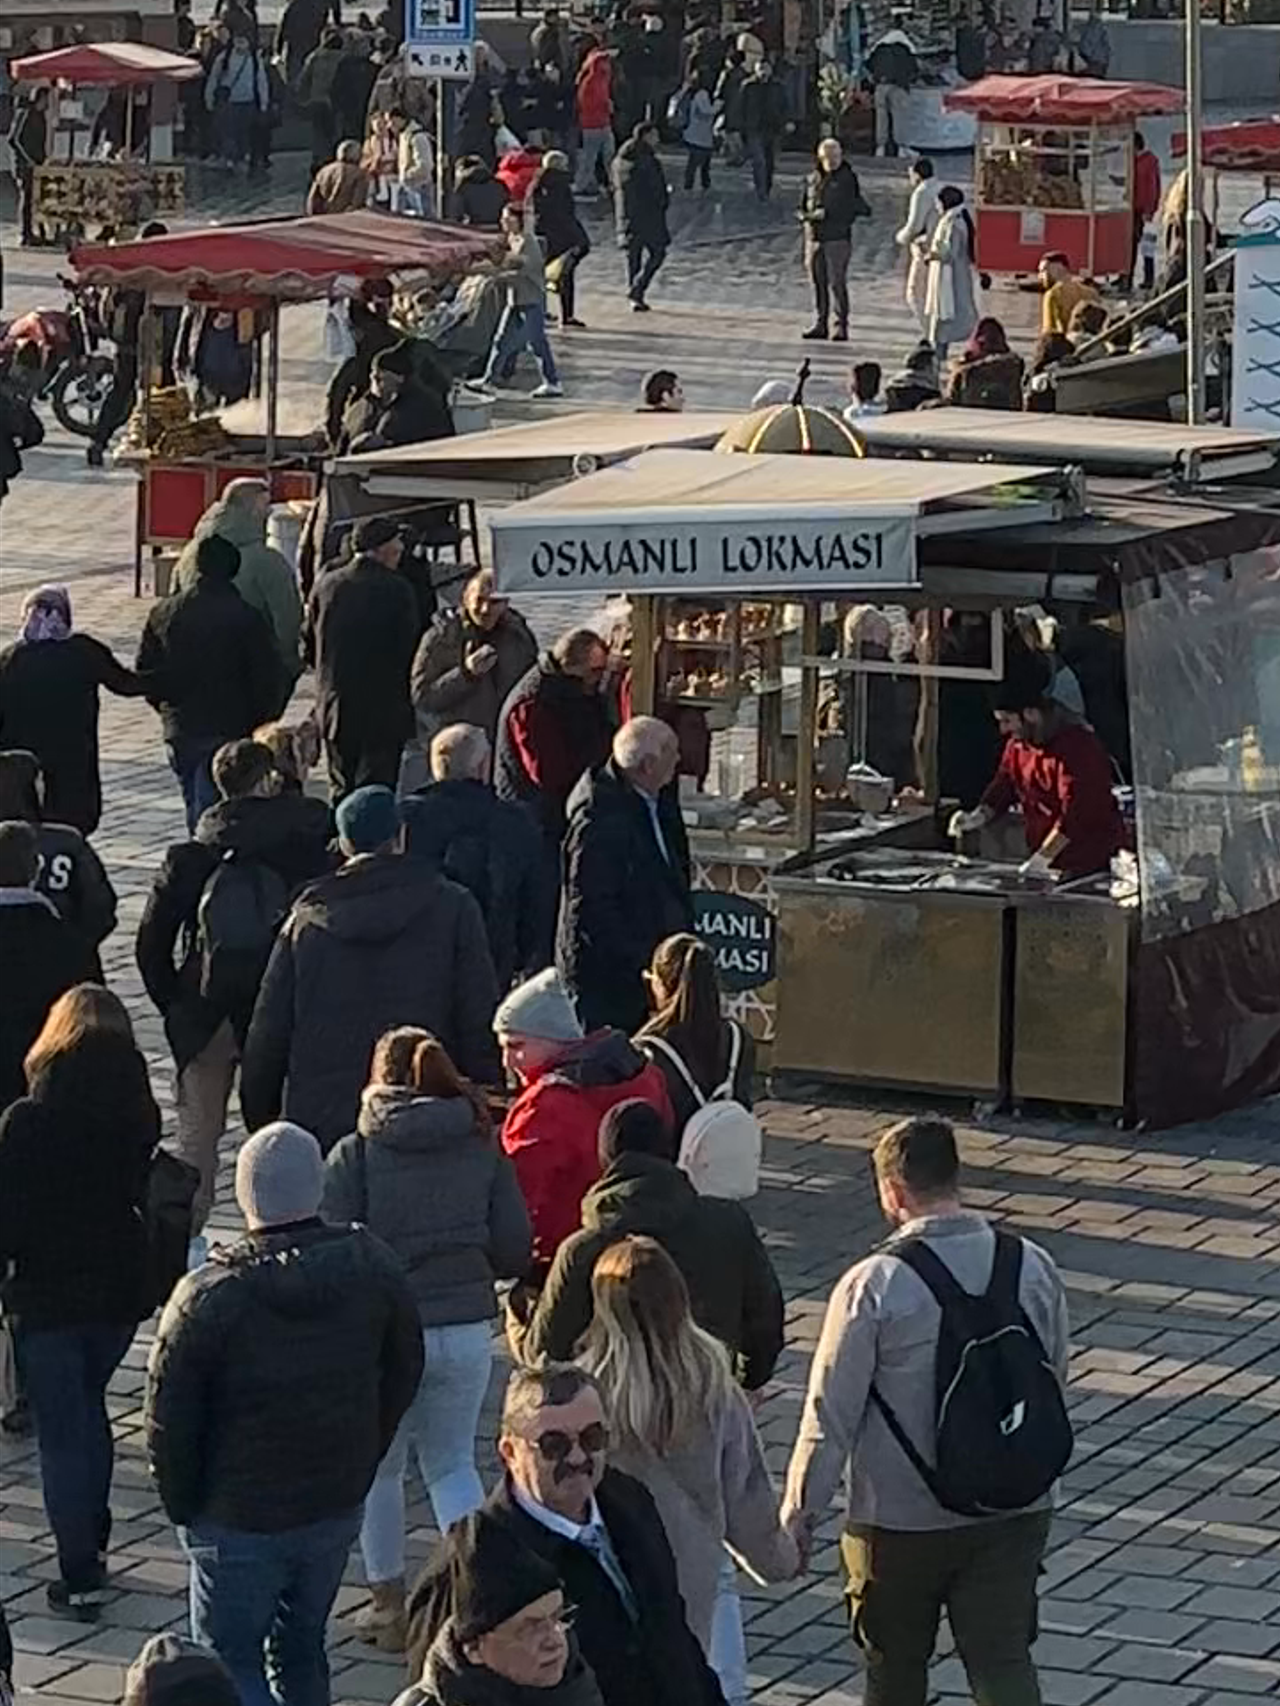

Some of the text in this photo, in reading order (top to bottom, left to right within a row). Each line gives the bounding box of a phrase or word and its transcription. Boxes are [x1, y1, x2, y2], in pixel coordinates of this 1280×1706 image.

[531, 532, 883, 577] OSMANLI LOKMASI
[695, 912, 770, 939] MANLI
